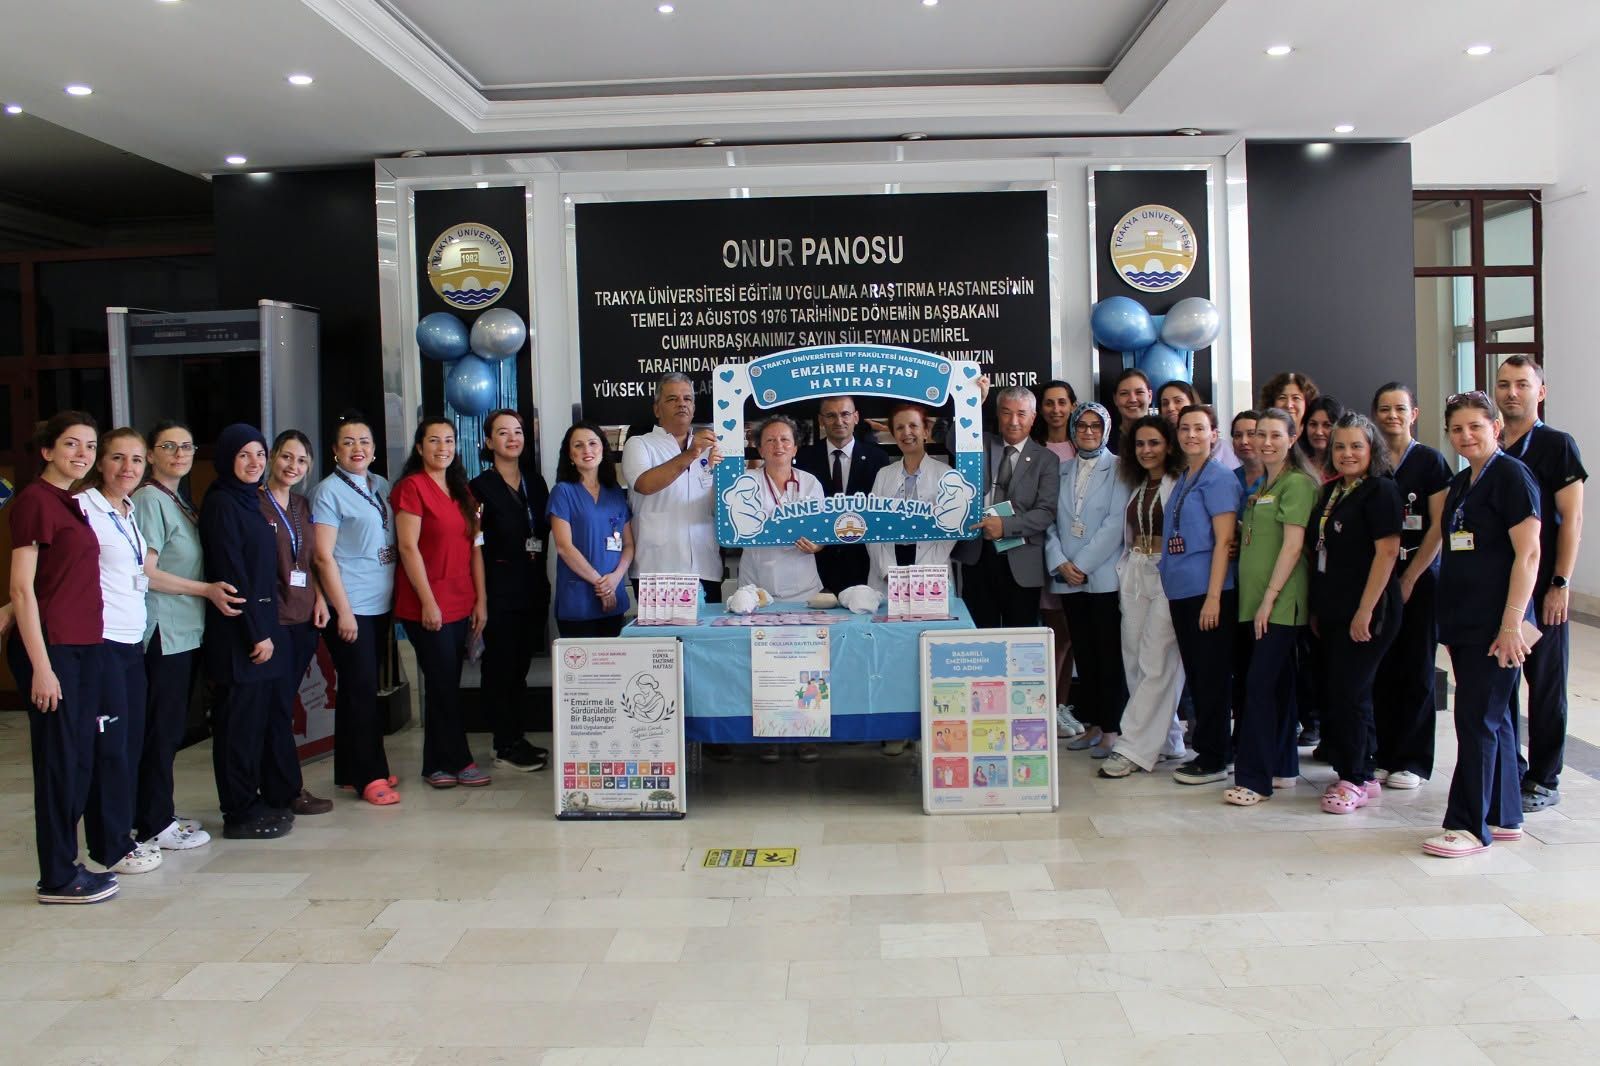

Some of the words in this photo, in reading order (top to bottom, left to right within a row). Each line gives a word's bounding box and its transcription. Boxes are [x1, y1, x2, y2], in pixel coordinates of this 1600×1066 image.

[1115, 216, 1139, 248] TRAKYA
[432, 235, 455, 267] TRAKYA
[722, 238, 795, 269] ONUR
[802, 235, 904, 266] PANOSU
[594, 289, 646, 306] TRAKYA
[648, 284, 736, 305] ÜNİVERSİTESİ
[739, 283, 782, 302] EĞİTİM
[785, 284, 858, 301] UYGULAMA
[860, 282, 936, 301] ARAŞTIRMA
[631, 308, 677, 328] TEMELİ
[679, 311, 694, 327] 23
[696, 307, 757, 326] AĞUSTOS
[761, 309, 788, 324] 1976
[790, 303, 858, 323] TARİHİNDE
[861, 302, 921, 322] DÖNEMİN
[924, 303, 999, 323] BAŞBAKANI
[661, 331, 796, 351] CUMHURBAŞKANIMIZ
[798, 329, 836, 346] SAYIN
[839, 326, 910, 344] SÜLEYMAN
[913, 324, 970, 343] DEMİREL
[638, 356, 719, 374] TARAFINDAN
[762, 358, 791, 370] TRAKYA
[792, 351, 843, 363] ÜNİVERSİTESİ
[858, 351, 897, 360] FAKÜLTESİ
[898, 355, 939, 369] HASTANESİ
[791, 363, 855, 379] EMZİRME
[860, 363, 919, 379] HAFTASI
[593, 379, 646, 398] YÜKSEK
[810, 376, 892, 390] HATIRASI
[772, 499, 819, 520] ANNE
[824, 493, 865, 512] SÜTÜ
[869, 493, 893, 511] İLK
[896, 499, 931, 517] AŞIM
